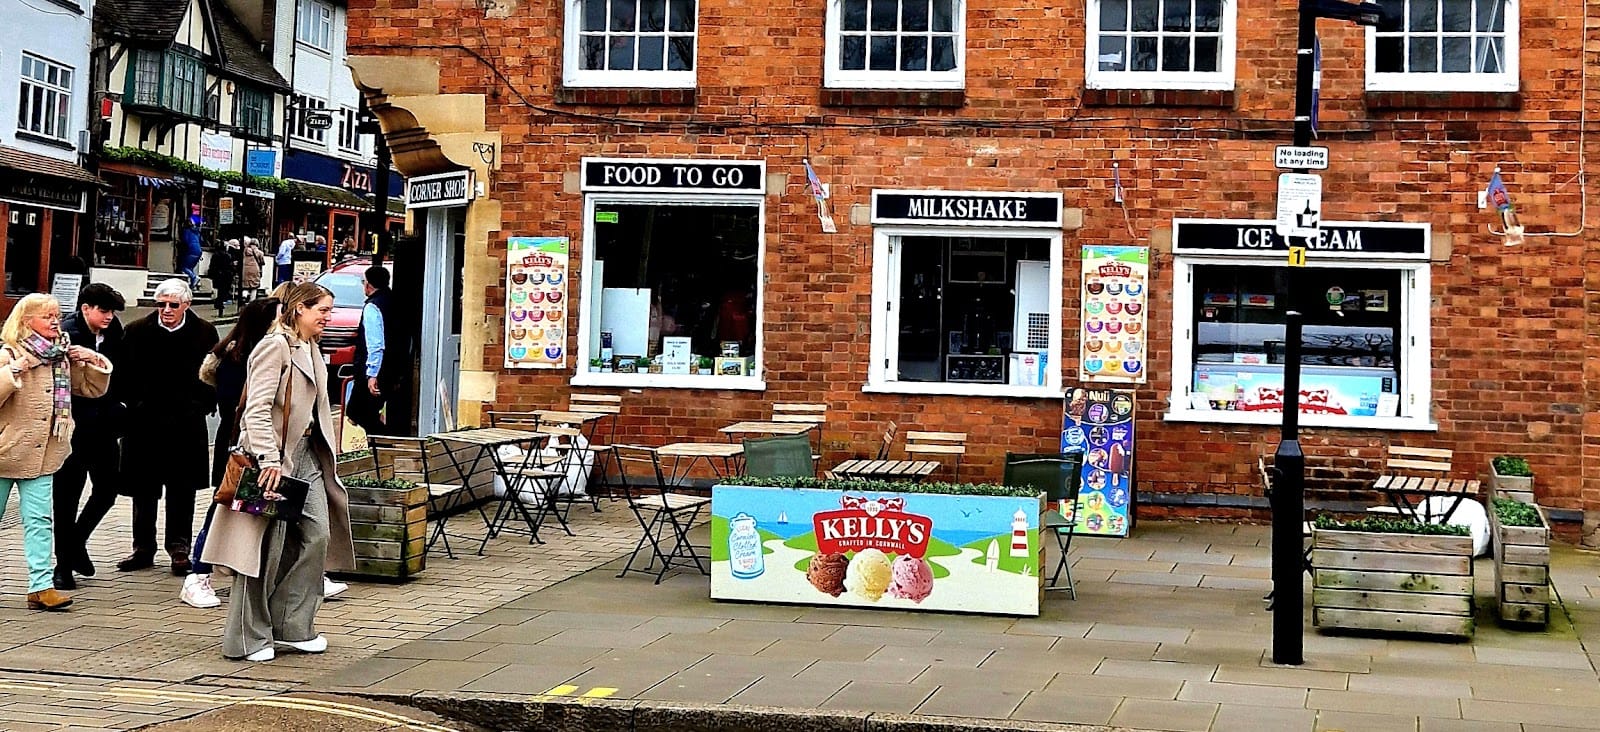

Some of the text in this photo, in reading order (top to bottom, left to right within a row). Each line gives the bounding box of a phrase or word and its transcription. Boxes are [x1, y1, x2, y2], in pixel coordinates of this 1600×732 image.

[1294, 149, 1324, 158] loading
[1306, 158, 1325, 166] time
[603, 165, 744, 187] FOOD TO GO
[410, 178, 466, 202] CORNER SHOP
[907, 198, 1028, 219] MILKSHAKE
[1237, 228, 1273, 248] ICE
[1293, 249, 1301, 264] 1
[1100, 266, 1130, 275] KELLY'S
[820, 516, 925, 544] KELLY'S
[875, 540, 905, 549] CORNWALL
